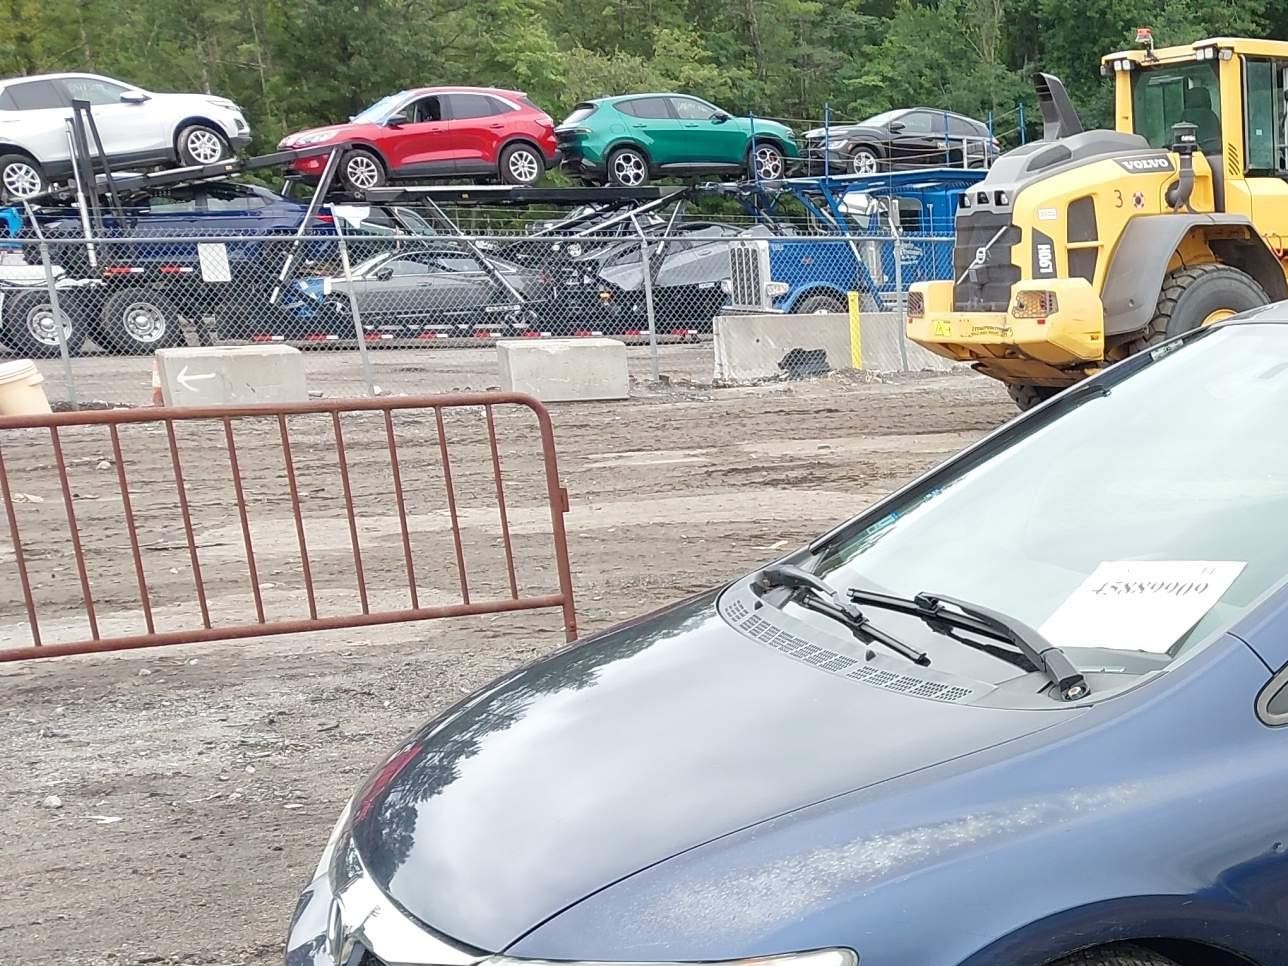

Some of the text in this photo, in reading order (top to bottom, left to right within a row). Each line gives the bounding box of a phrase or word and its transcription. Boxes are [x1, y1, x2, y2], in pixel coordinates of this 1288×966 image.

[1122, 158, 1168, 170] VOLVO
[1114, 189, 1124, 208] 3
[1037, 244, 1053, 274] L90H
